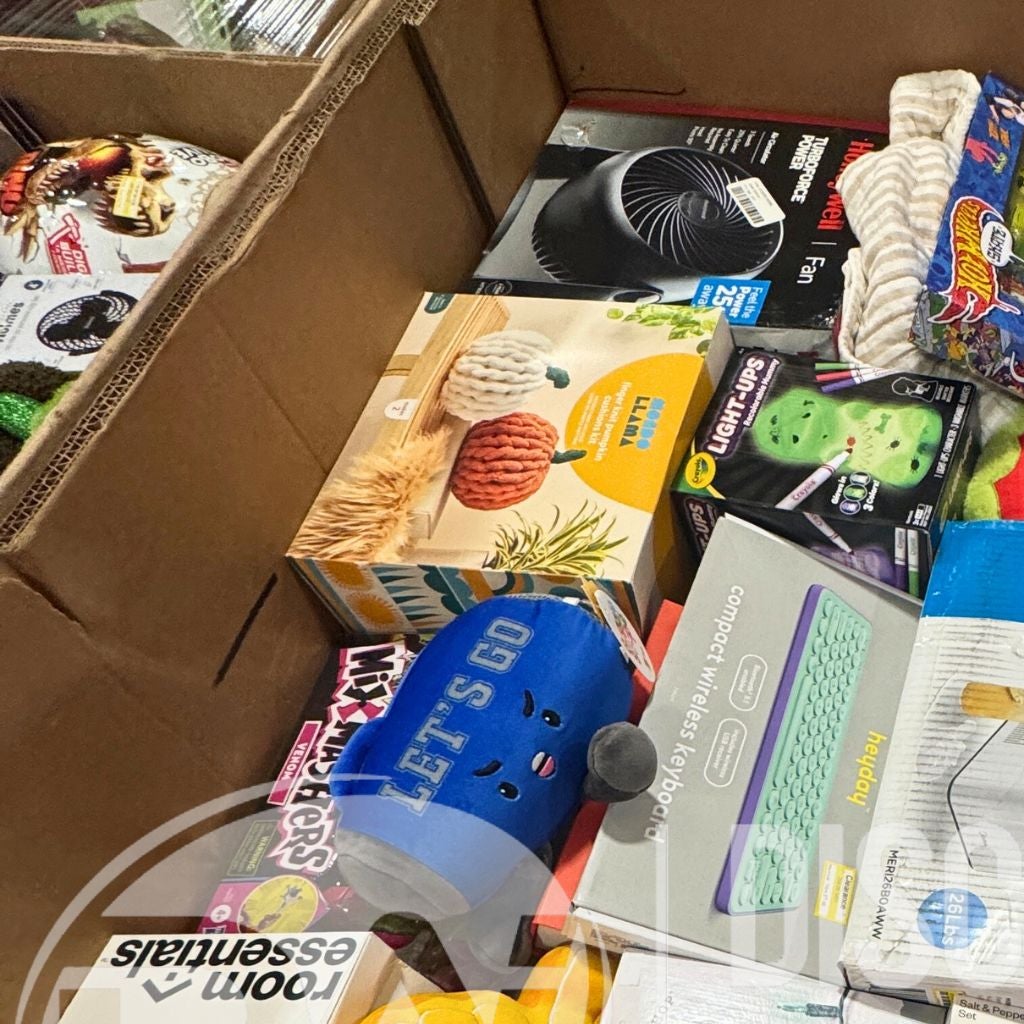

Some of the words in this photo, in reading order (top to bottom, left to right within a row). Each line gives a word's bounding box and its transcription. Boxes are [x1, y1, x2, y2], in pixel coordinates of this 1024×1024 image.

[789, 134, 811, 171] POWER
[790, 134, 829, 203] TURBOFORCE
[817, 139, 874, 230] Howell
[987, 226, 1006, 264] SKATE
[797, 256, 825, 284] Fan
[729, 286, 748, 318] Power
[740, 304, 755, 319] the
[747, 287, 763, 305] Feel
[707, 357, 765, 454] LIGHT-UPS
[863, 503, 874, 512] 3
[706, 583, 745, 665] compact
[379, 674, 497, 817] LET'S
[467, 616, 534, 674] GO
[681, 663, 718, 744] wireless
[279, 742, 307, 782] VENOM
[846, 731, 887, 808] heyday
[644, 747, 695, 844] keyboard
[110, 936, 358, 978] essentials
[200, 970, 343, 1002] room
[959, 998, 980, 1011] Salt
[958, 1009, 977, 1021] Set
